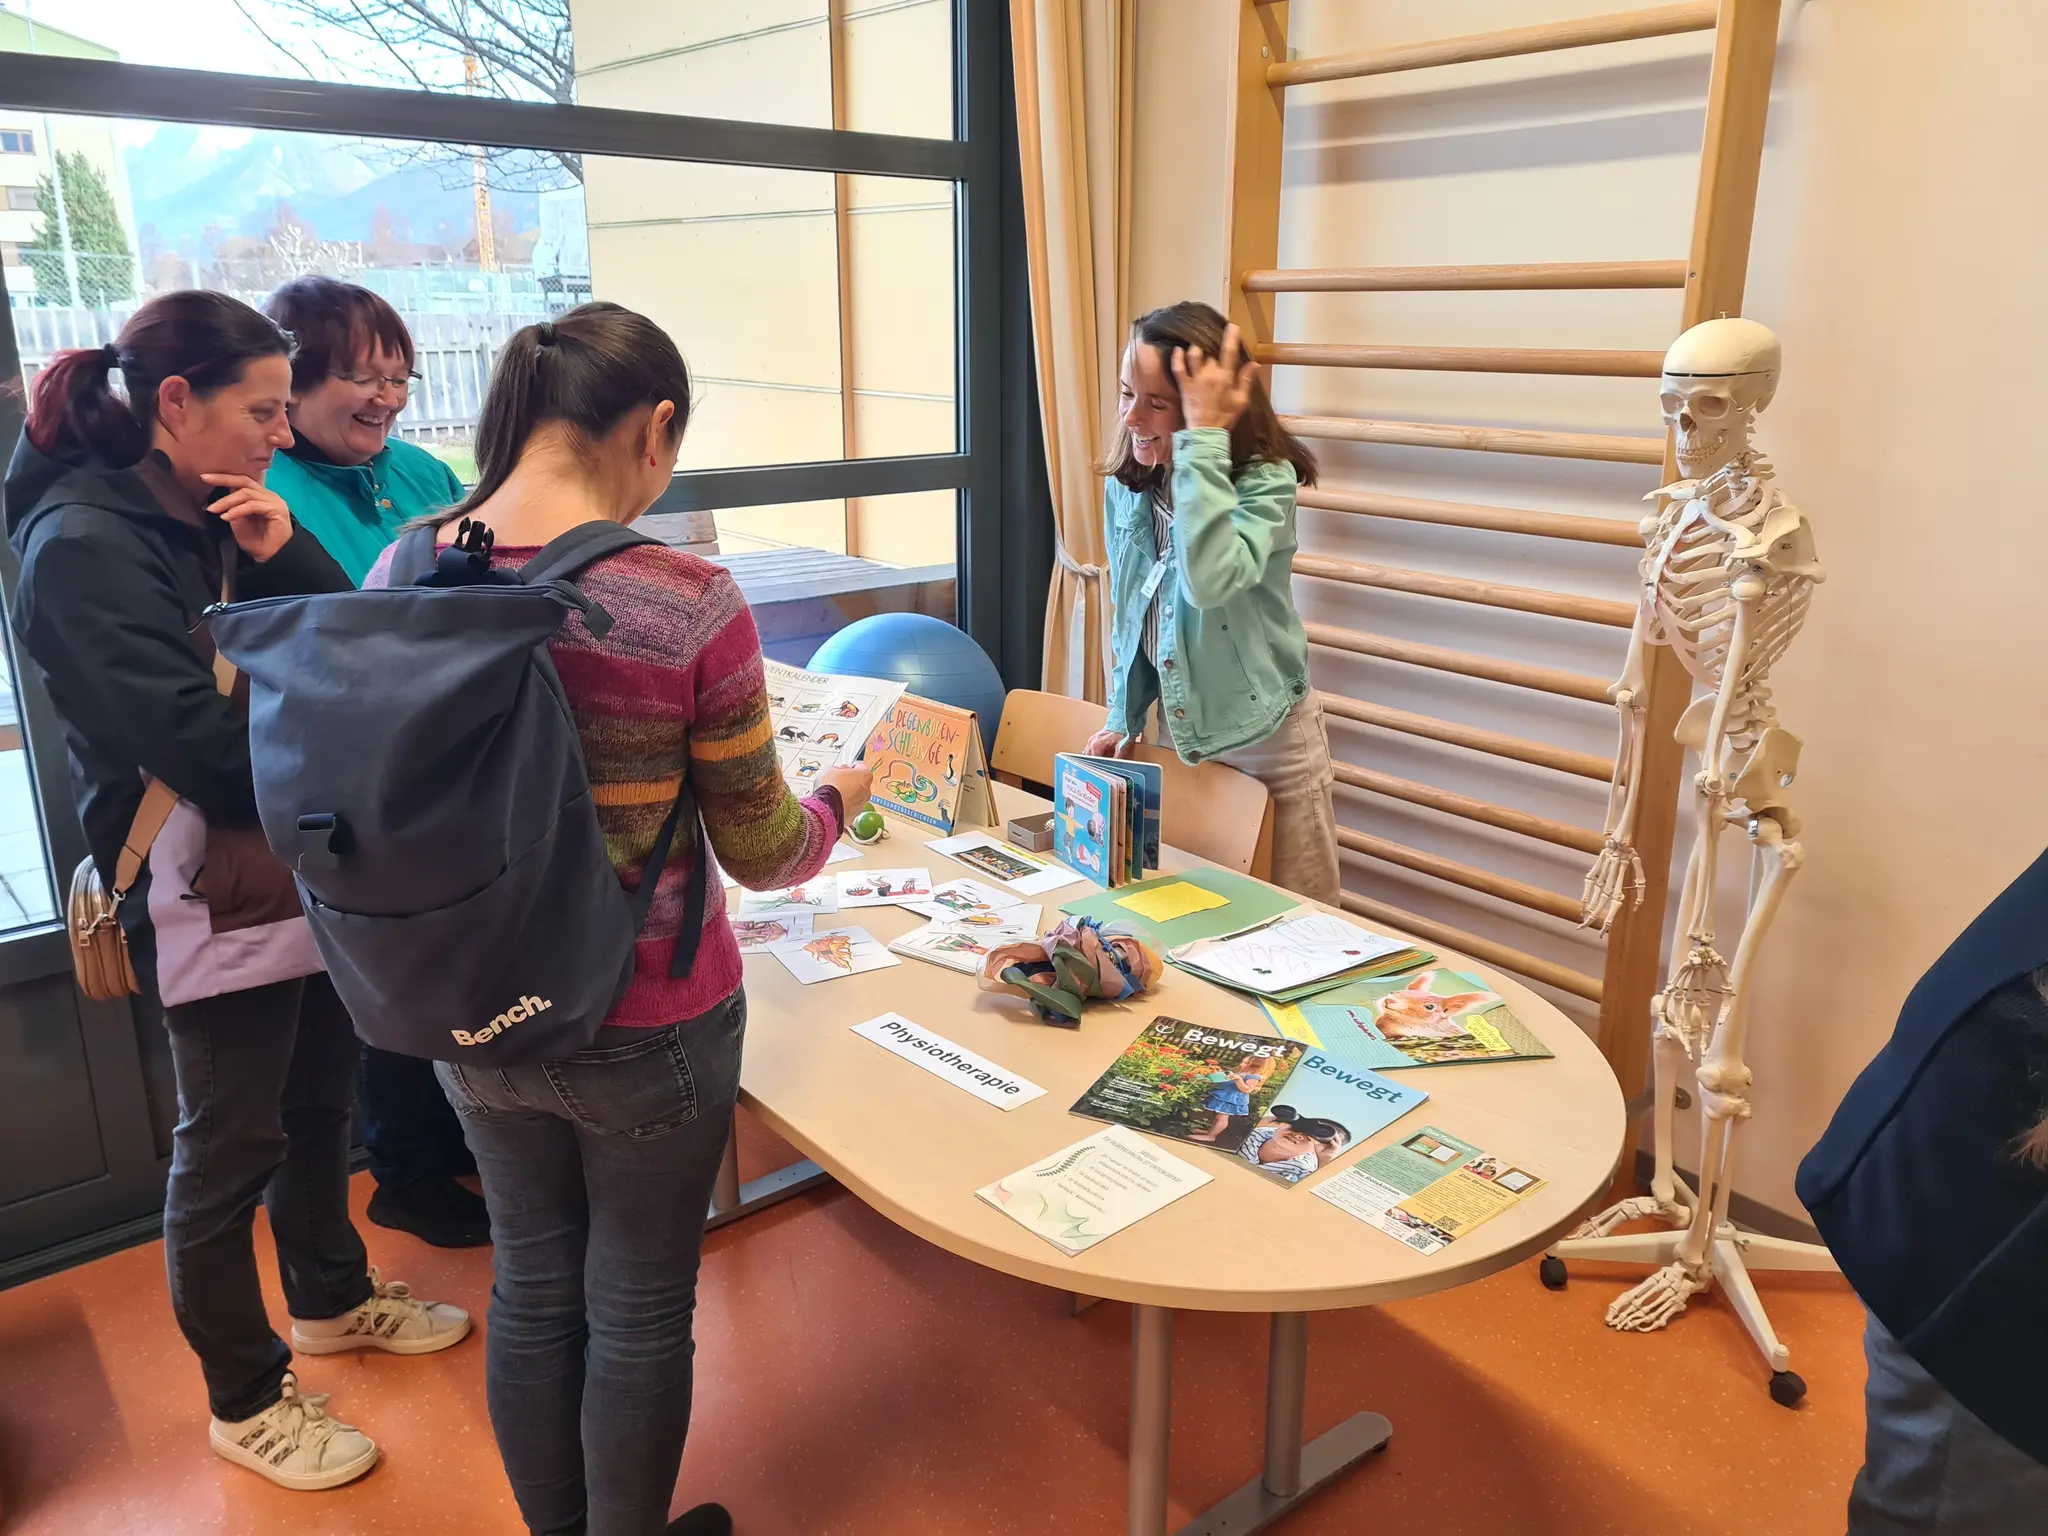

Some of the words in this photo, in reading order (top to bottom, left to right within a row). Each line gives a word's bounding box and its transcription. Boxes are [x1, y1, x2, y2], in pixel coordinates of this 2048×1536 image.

[764, 664, 830, 685] VENTKALENDER
[895, 709, 960, 744] REGENBOGEN-
[885, 728, 943, 765] SCHLANGE
[451, 995, 552, 1046] Bench.
[880, 1021, 1020, 1095] Physiotherapie
[1183, 1027, 1287, 1058] Bewegt
[1303, 1055, 1403, 1104] Bewegt
